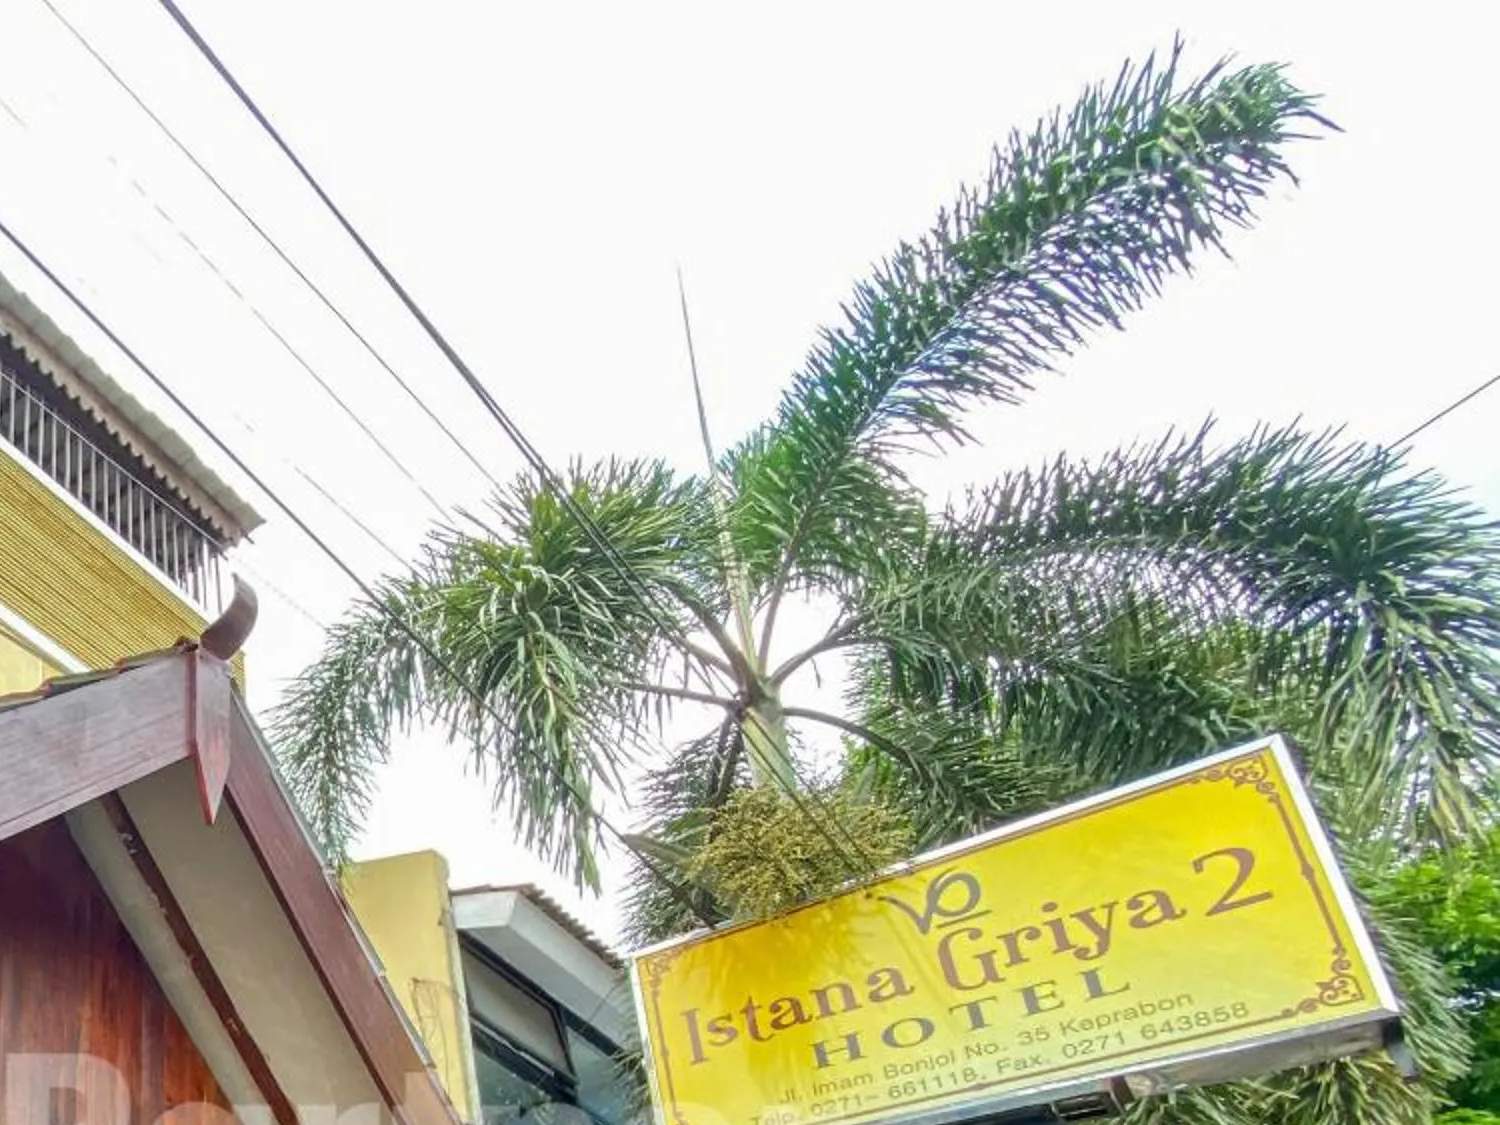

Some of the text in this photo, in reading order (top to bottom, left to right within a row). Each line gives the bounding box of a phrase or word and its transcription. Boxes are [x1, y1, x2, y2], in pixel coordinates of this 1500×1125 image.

[681, 847, 1273, 1066] Istana Griya 2
[810, 967, 1130, 1069] HOTEL
[813, 1072, 874, 1096] Imam
[883, 1050, 956, 1080] Bonjol
[965, 1041, 1004, 1057] No.
[1018, 1026, 1050, 1045] 35
[1063, 1030, 1126, 1059] 0271
[1140, 1001, 1250, 1041] 643858
